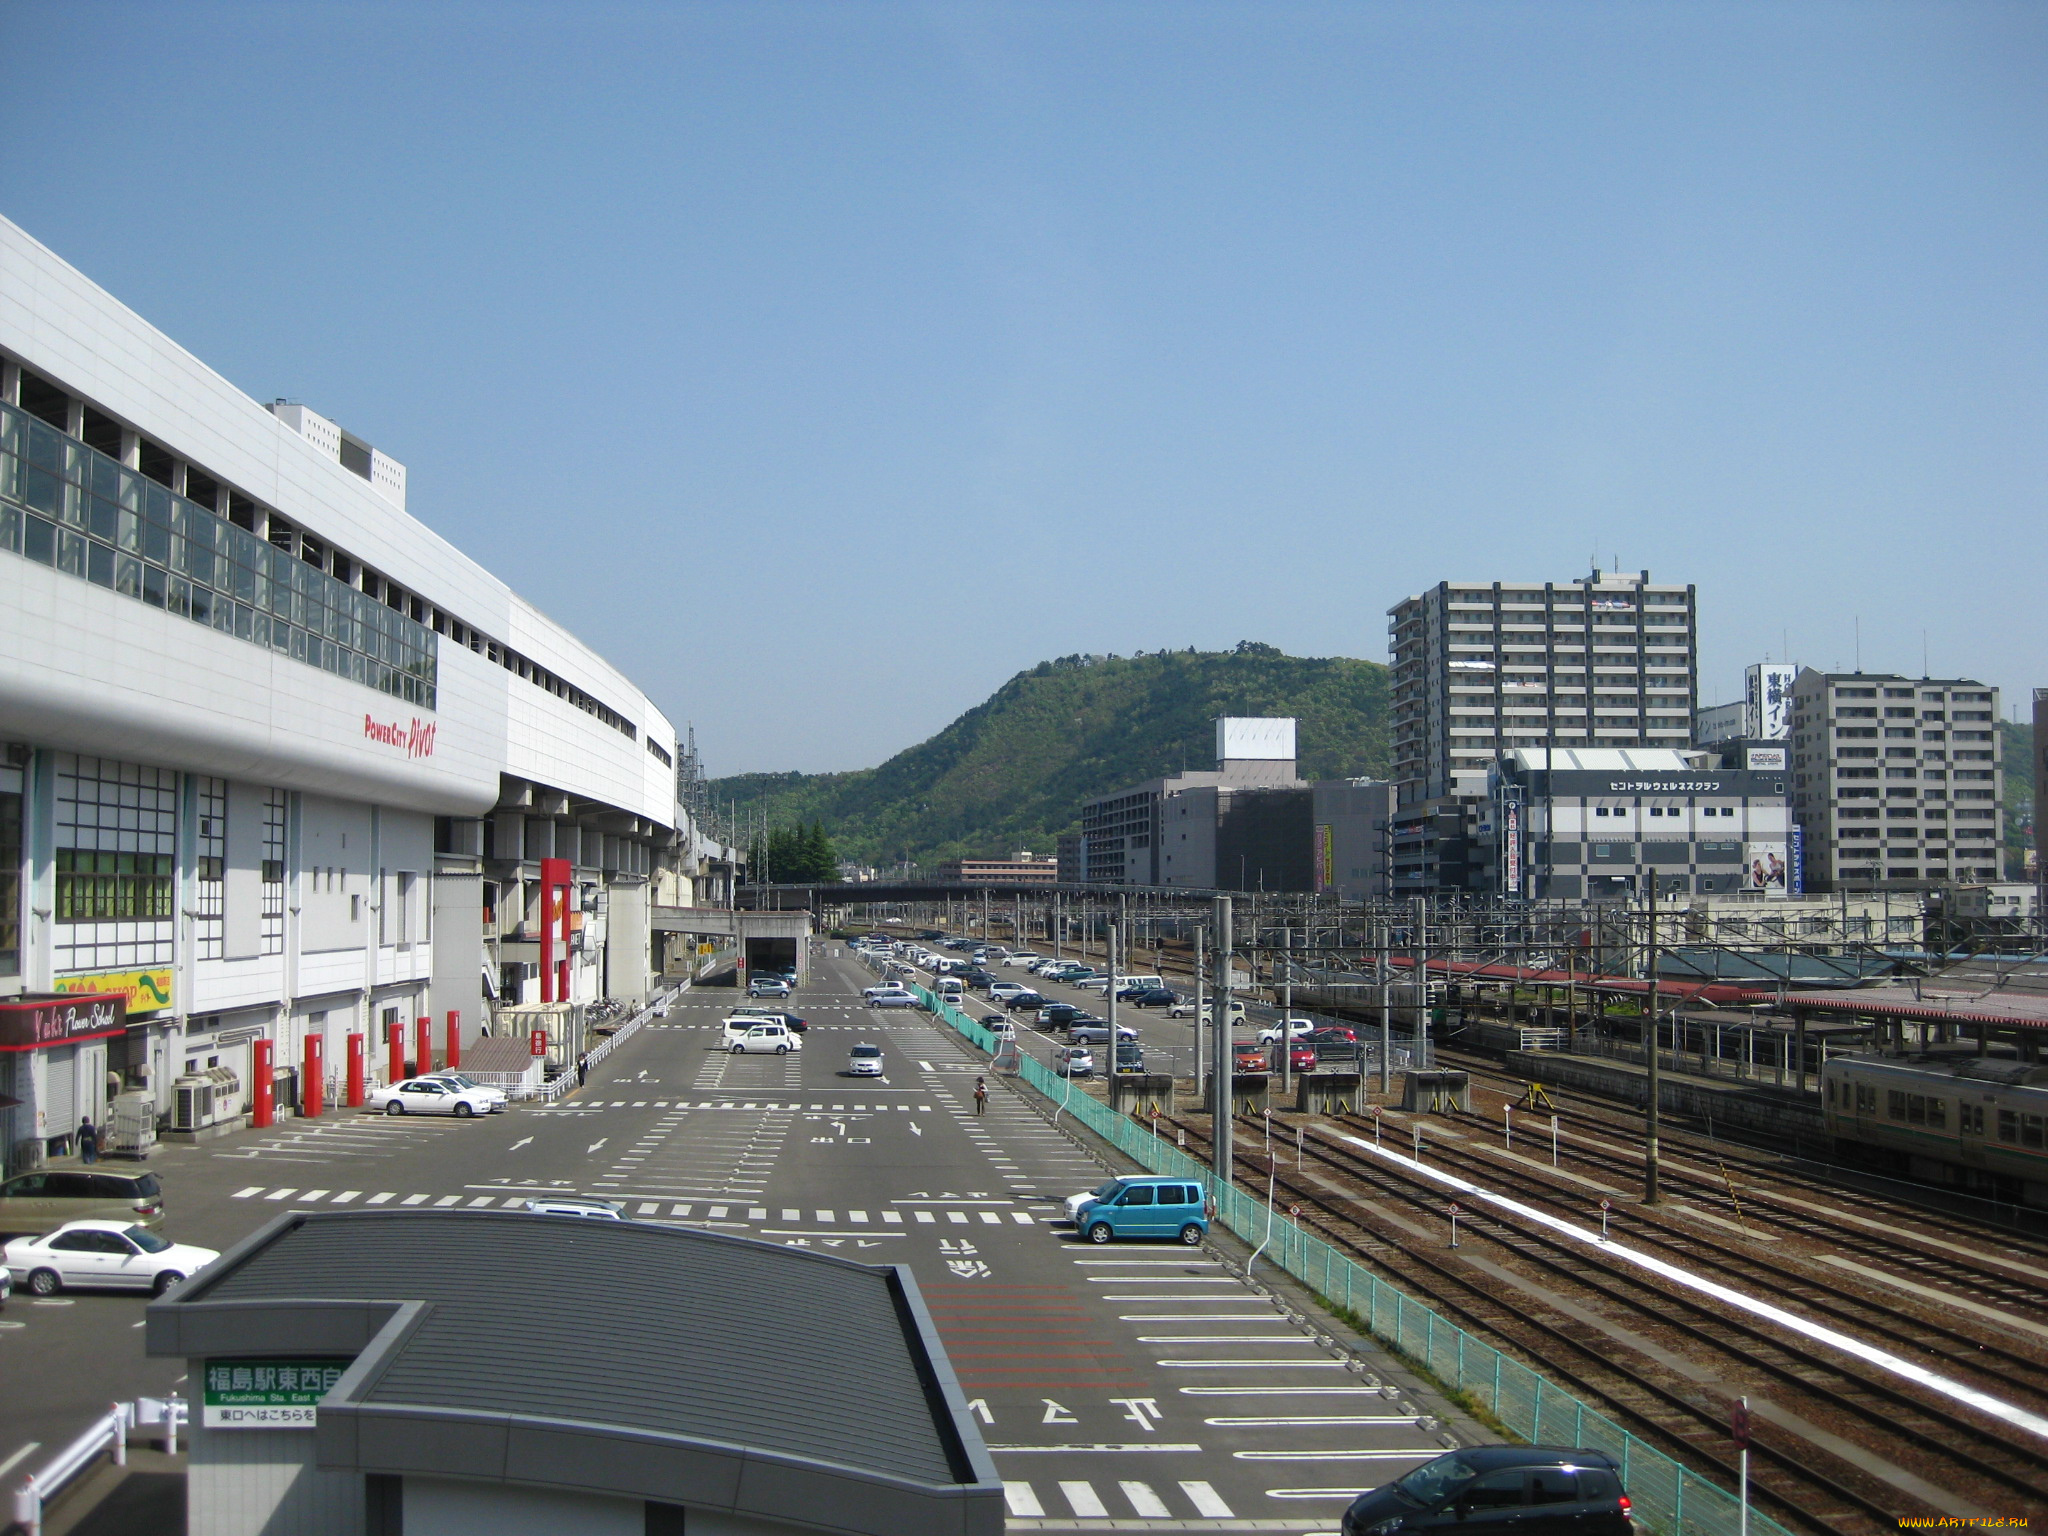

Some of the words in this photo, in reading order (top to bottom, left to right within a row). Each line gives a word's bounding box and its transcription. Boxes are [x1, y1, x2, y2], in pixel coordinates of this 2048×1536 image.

[1766, 672, 1784, 737] 東横イン
[1609, 781, 1720, 791] セントラルウェルネスクラブ
[105, 986, 137, 1008] OP
[65, 1007, 91, 1038] Flower
[90, 1003, 115, 1029] School
[209, 1366, 342, 1391] 福島駅東西自
[220, 1393, 266, 1402] Fukushima
[270, 1393, 287, 1402] Sta.
[291, 1393, 311, 1402] East
[220, 1409, 315, 1421] 東口へはこちらを
